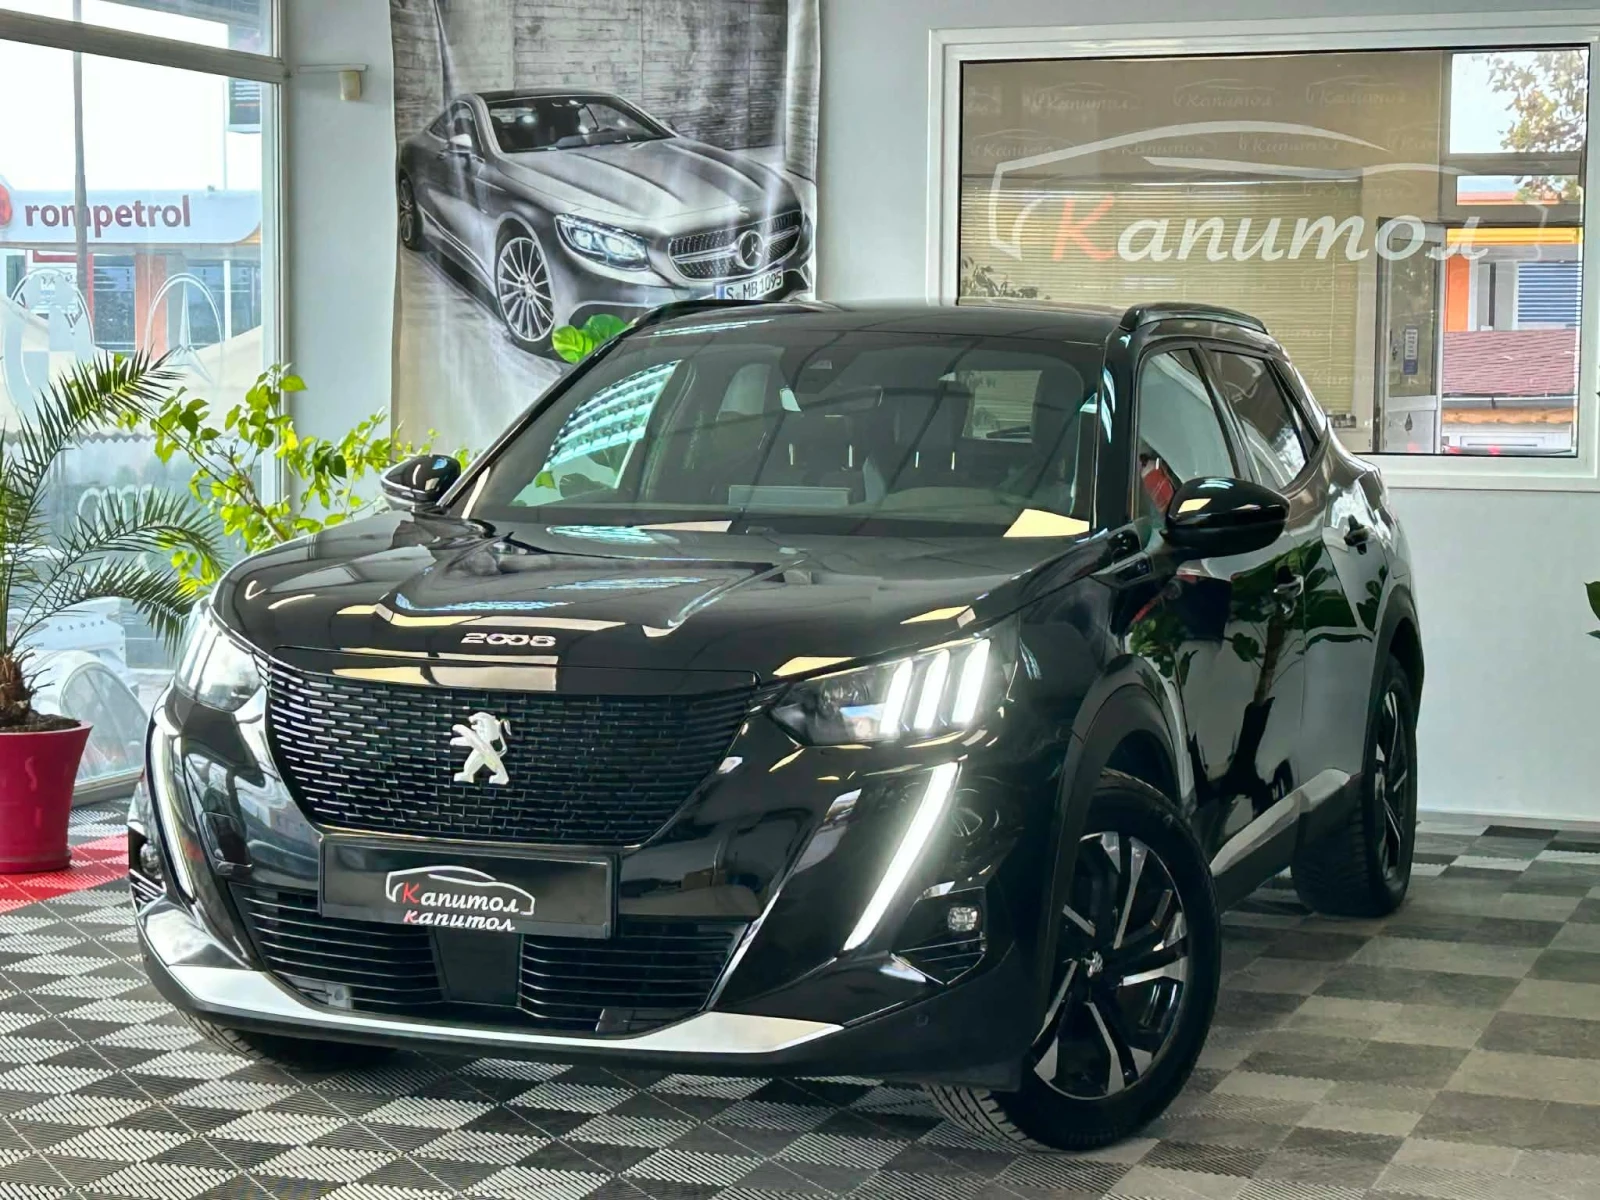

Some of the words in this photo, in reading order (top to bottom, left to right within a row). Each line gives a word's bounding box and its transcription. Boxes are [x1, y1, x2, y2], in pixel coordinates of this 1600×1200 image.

[25, 194, 191, 238] rompetrol
[1052, 192, 1489, 262] Капитол
[460, 632, 556, 647] 2008
[401, 881, 520, 914] Капитол
